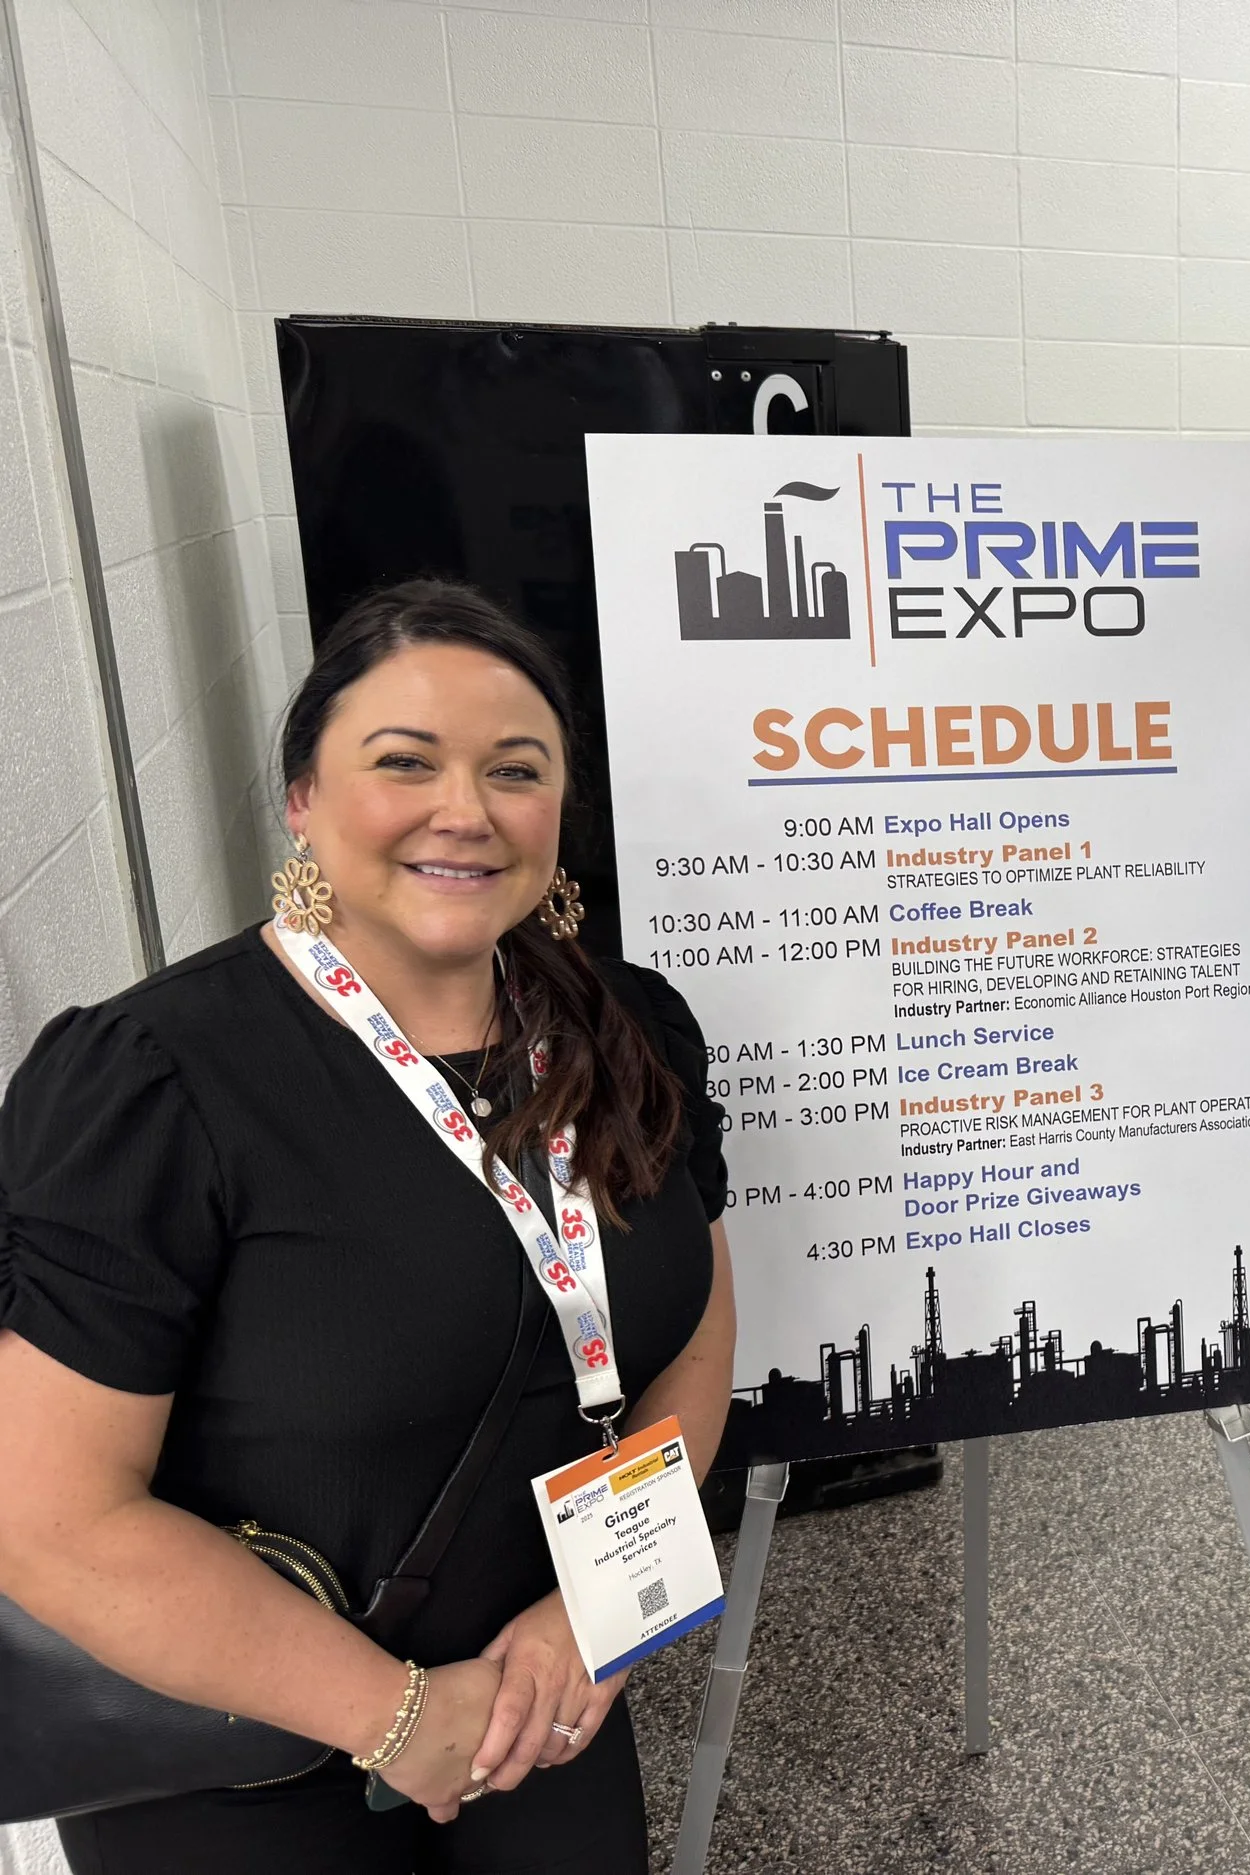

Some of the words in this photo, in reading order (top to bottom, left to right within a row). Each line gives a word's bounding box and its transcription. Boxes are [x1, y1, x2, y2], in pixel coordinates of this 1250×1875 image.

[881, 481, 1004, 514] THE
[883, 519, 1201, 580] PRIME
[888, 585, 1147, 640] EXPO
[752, 700, 1173, 772] SCHEDULE
[783, 817, 832, 838] 9:00
[837, 815, 874, 836] AM
[884, 815, 942, 838] Expo
[949, 811, 992, 832] Hall
[998, 811, 1070, 834] Opens
[655, 856, 706, 878] 9:30
[711, 854, 749, 876] AM
[773, 851, 834, 873] 10:30
[839, 849, 876, 870] AM
[886, 847, 994, 869] Industry
[1002, 842, 1071, 863] Panel
[1080, 840, 1091, 859] 1
[887, 870, 979, 890] STRATEGIES
[981, 869, 1002, 885] TO
[1005, 866, 1073, 884] OPTIMIZE
[1076, 864, 1122, 881] PLANT
[1124, 860, 1206, 879] RELIABILITY
[648, 912, 712, 935] 10:30
[716, 910, 755, 932] AM
[779, 906, 838, 928] 11:00
[842, 904, 879, 925] AM
[889, 901, 962, 923] Coffee
[969, 897, 1034, 919] Break
[649, 947, 710, 970] 11:00
[715, 944, 754, 966] AM
[778, 940, 838, 962] 12:00
[845, 937, 881, 959] PM
[891, 934, 998, 956] Industry
[1006, 927, 1075, 950] Panel
[1083, 927, 1098, 945] 2
[891, 958, 961, 977] BUILDING
[963, 956, 994, 973] THE
[997, 953, 1055, 971] FUTURE
[1057, 947, 1153, 967] WORKFORCE:
[1156, 942, 1241, 961] STRATEGIES
[325, 967, 362, 997] 3S
[893, 981, 925, 998] FOR
[927, 978, 983, 996] HIRING,
[986, 972, 1078, 992] DEVELOPING
[1080, 970, 1110, 986] AND
[1113, 965, 1187, 984] RETAINING
[1189, 962, 1241, 980] TALENT
[893, 1001, 952, 1019] Industry
[955, 999, 1010, 1015] Partner:
[1014, 993, 1077, 1011] Economic
[1078, 991, 1127, 1007] Alliance
[1130, 987, 1182, 1003] Houston
[1184, 984, 1211, 1000] Port
[736, 1041, 774, 1063] AM
[797, 1036, 844, 1058] 1:30
[850, 1033, 886, 1055] PM
[896, 1028, 966, 1051] Lunch
[973, 1023, 1055, 1046] Service
[384, 1040, 419, 1067] 3S
[897, 1065, 931, 1084] Ice
[937, 1062, 1009, 1081] Cream
[1016, 1053, 1079, 1075] Break
[739, 1074, 775, 1097] PM
[797, 1070, 845, 1092] 2:00
[852, 1066, 888, 1088] PM
[899, 1093, 1006, 1117] Industry
[1013, 1085, 1082, 1108] Panel
[1089, 1083, 1104, 1101] 3
[443, 1111, 473, 1142] 3S
[741, 1109, 777, 1132] PM
[799, 1104, 847, 1126] 3:00
[854, 1100, 890, 1122] PM
[900, 1117, 983, 1138] PROACTIVE
[985, 1114, 1019, 1131] RISK
[1021, 1106, 1120, 1128] MANAGEMENT
[1122, 1104, 1152, 1120] FOR
[1154, 1100, 1197, 1118] PLANT
[900, 1141, 954, 1158] Industry
[956, 1137, 1006, 1153] Partner:
[1009, 1133, 1036, 1148] East
[1038, 1129, 1073, 1146] Harris
[1075, 1127, 1116, 1143] County
[1118, 1122, 1198, 1139] Manufacturers
[745, 1184, 782, 1207] PM
[803, 1179, 851, 1201] 4:00
[858, 1174, 893, 1197] PM
[903, 1170, 975, 1193] Happy
[981, 1164, 1035, 1184] Hour
[1040, 1157, 1080, 1178] and
[904, 1199, 960, 1218] Door
[965, 1191, 1020, 1212] Prize
[1026, 1182, 1142, 1206] Giveaways
[562, 1208, 586, 1240] 3S
[906, 1231, 963, 1252] Expo
[969, 1222, 1011, 1244] Hall
[1017, 1219, 1091, 1239] Closes
[806, 1239, 854, 1262] 4:30
[861, 1234, 896, 1257] PM
[547, 1262, 577, 1292] 3S
[582, 1338, 608, 1368] 3S
[663, 1447, 680, 1461] CAT
[575, 1484, 608, 1507] PRIME
[619, 1479, 656, 1501] REGISTRATION
[657, 1465, 682, 1482] SPONSOR
[577, 1494, 604, 1514] EXPO
[605, 1498, 650, 1528] Ginger
[594, 1537, 637, 1566] Industrial
[639, 1516, 677, 1541] Specialty
[614, 1517, 650, 1540] Teague
[622, 1540, 658, 1563] Services
[640, 1613, 678, 1639] ATTENDEE
